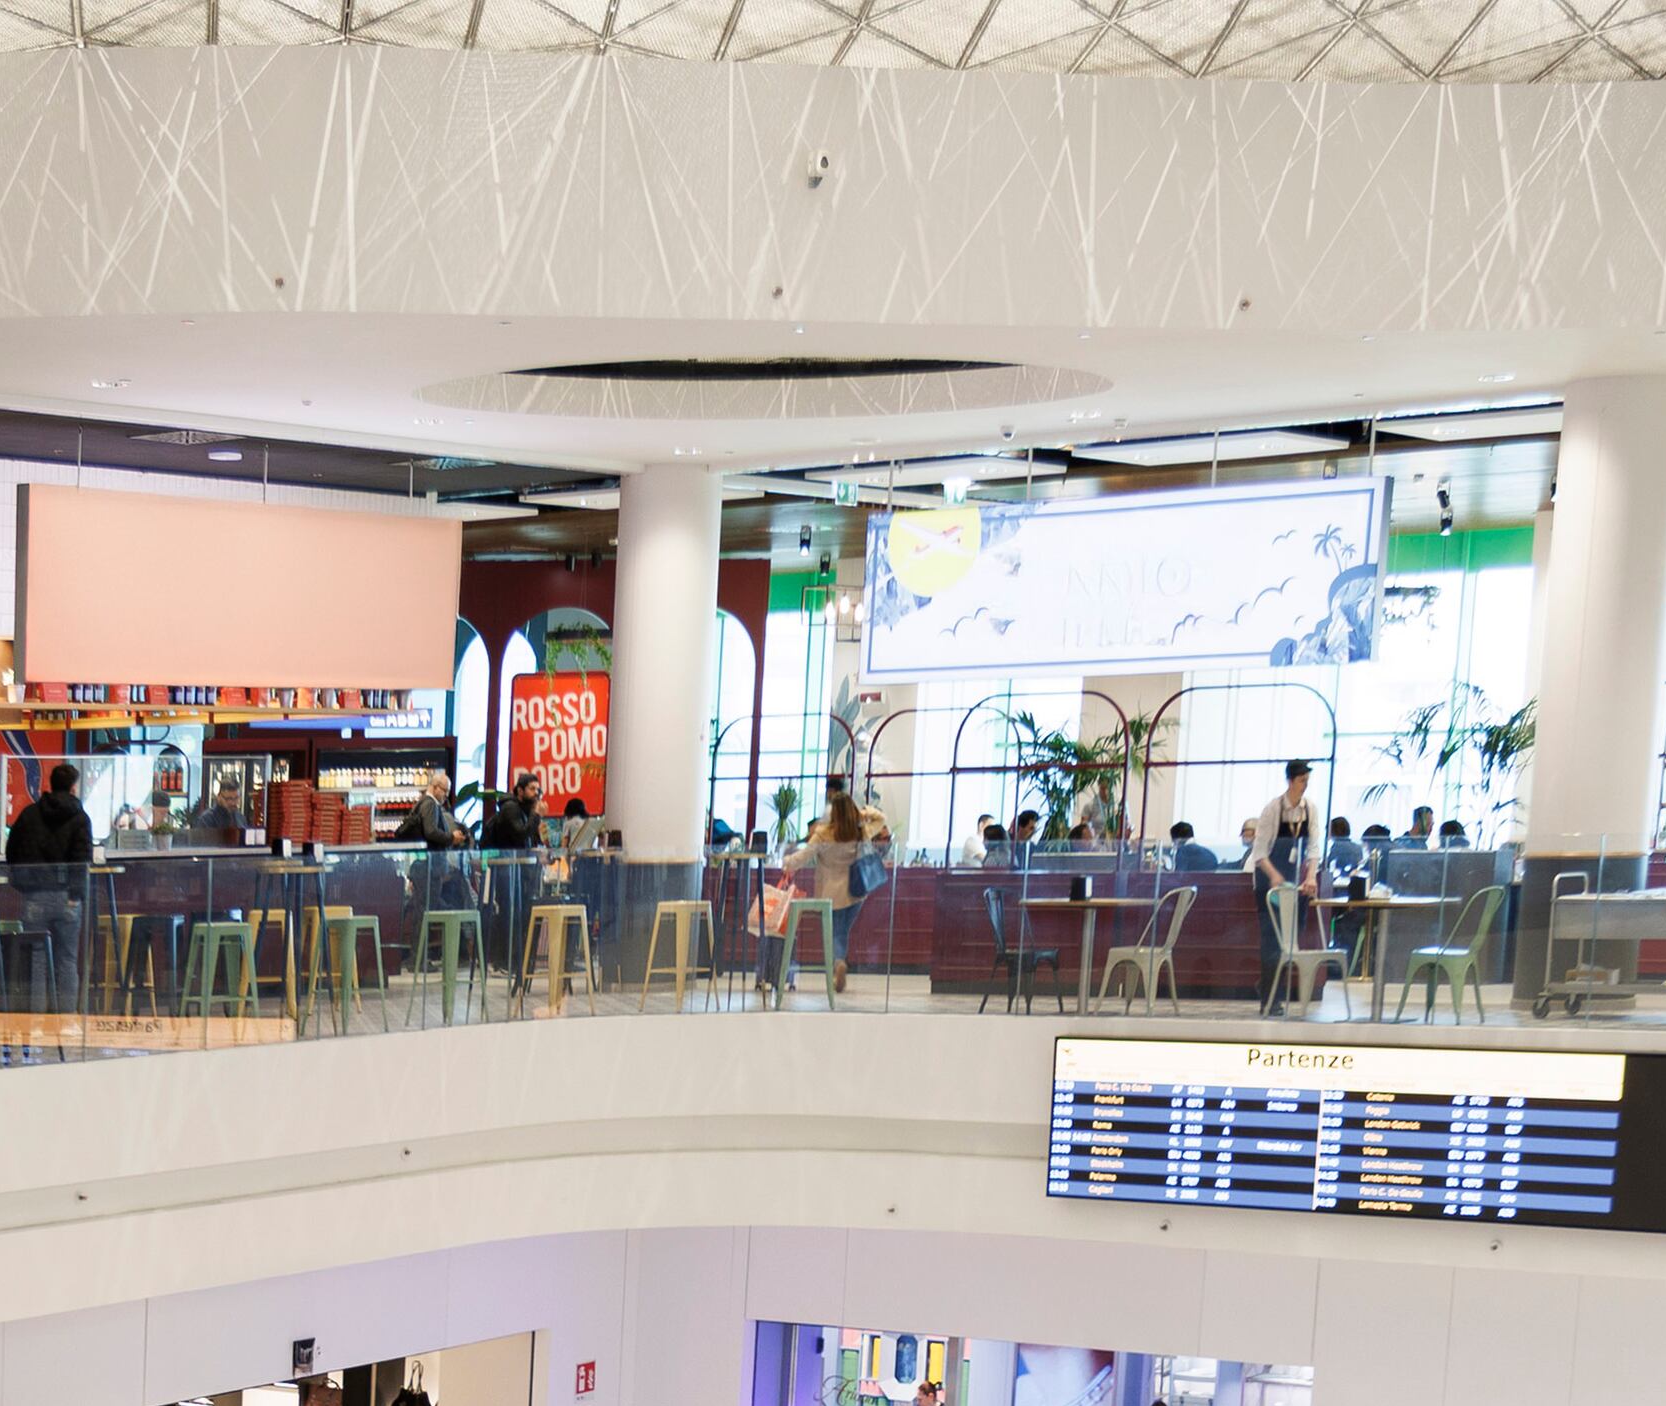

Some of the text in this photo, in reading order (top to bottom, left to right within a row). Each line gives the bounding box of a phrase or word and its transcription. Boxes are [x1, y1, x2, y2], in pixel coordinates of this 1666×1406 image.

[512, 691, 597, 732] ROSSO
[534, 724, 607, 763] POMO
[1247, 1048, 1355, 1072] Partenze
